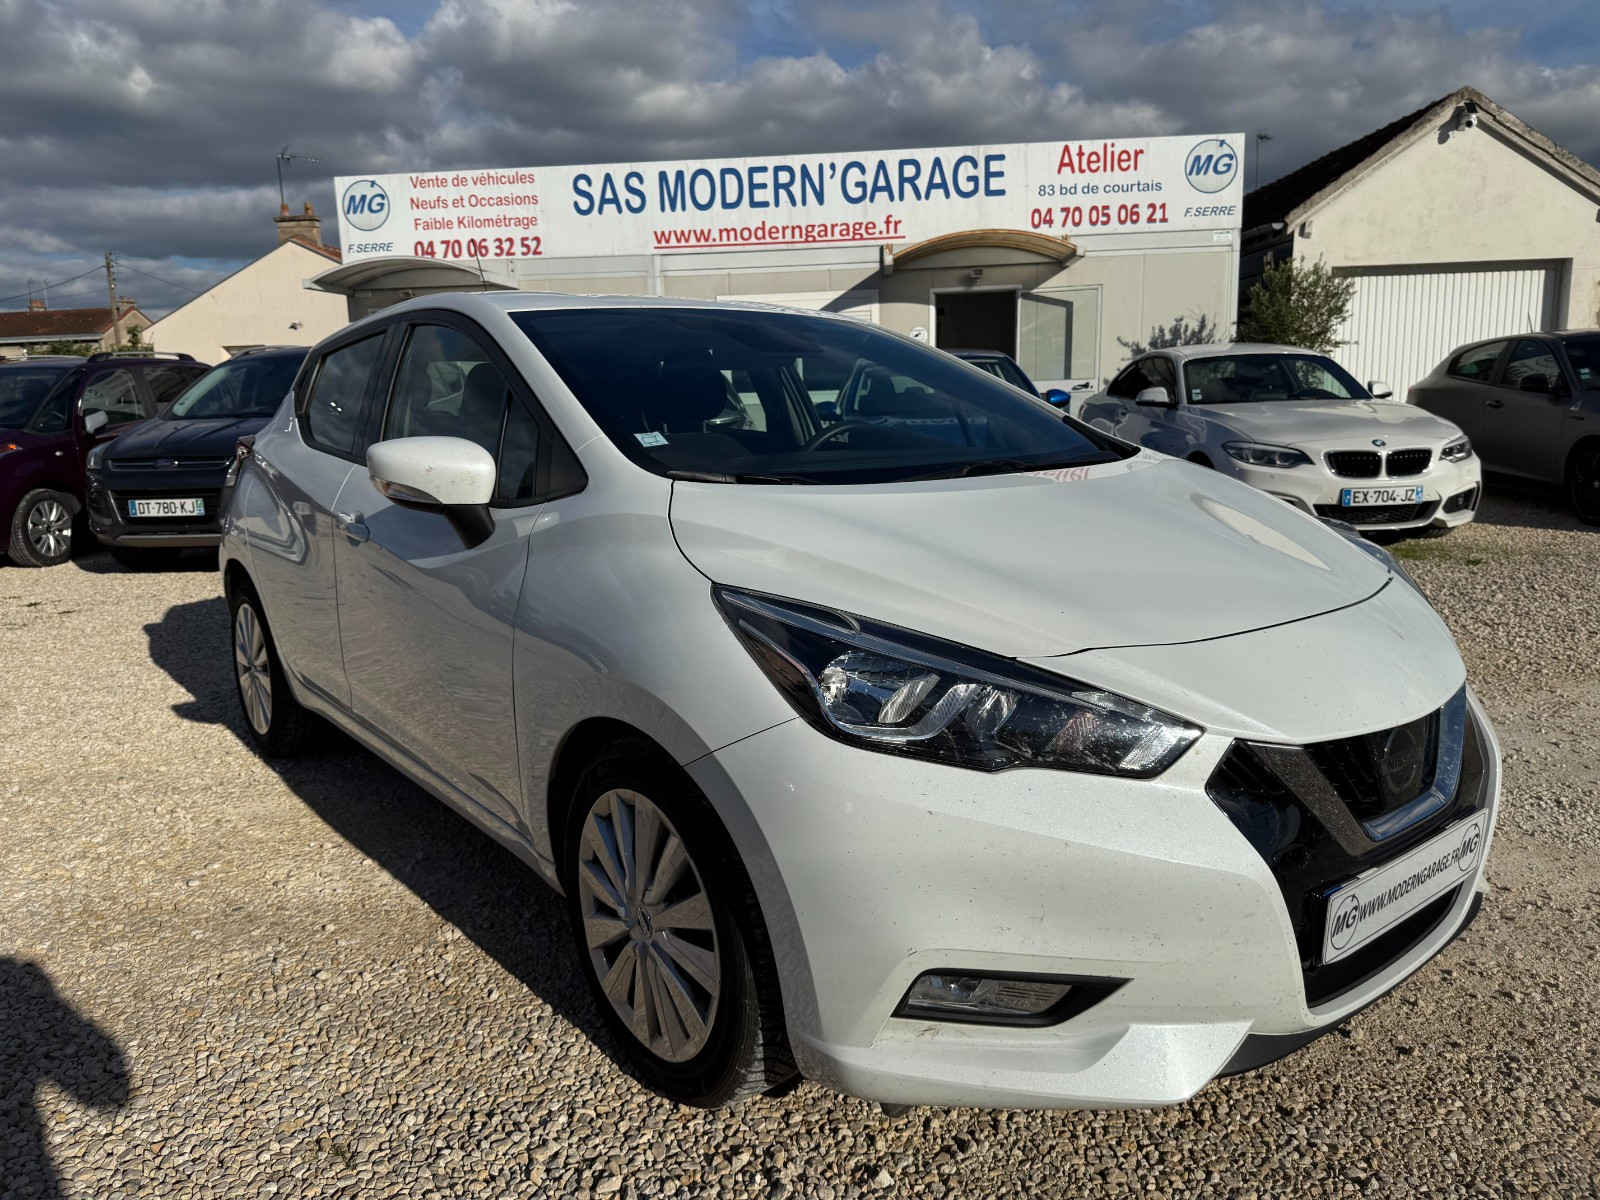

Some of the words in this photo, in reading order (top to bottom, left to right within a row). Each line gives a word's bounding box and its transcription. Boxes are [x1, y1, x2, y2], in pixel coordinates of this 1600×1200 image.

[1057, 142, 1144, 175] Atelier
[1188, 153, 1234, 176] MG
[410, 175, 448, 189] Vente
[452, 174, 468, 187] de
[471, 171, 535, 186] véhicules
[572, 171, 647, 216] SAS
[658, 154, 1006, 213] MODERN'GARAGE
[1038, 184, 1055, 196] 83
[1059, 183, 1077, 196] bd
[1081, 183, 1099, 194] de
[1103, 179, 1162, 193] courtais
[346, 193, 386, 215] MG
[410, 195, 448, 210] Neufs
[452, 195, 465, 208] et
[468, 193, 539, 208] Occasions
[1184, 205, 1237, 217] F.SERRE
[414, 217, 454, 231] Faible
[457, 214, 538, 230] Kilométrage
[1031, 207, 1054, 229] 04
[1060, 206, 1083, 228] 70
[1088, 205, 1111, 227] 05
[1117, 203, 1140, 225] 06
[1146, 202, 1169, 224] 21
[653, 214, 903, 245] www.moderngarage.fr
[347, 242, 394, 253] F.SERRE
[414, 240, 437, 258] 04
[440, 239, 463, 259] 70
[467, 238, 489, 258] 06
[493, 237, 516, 257] 32
[520, 236, 543, 256] 52
[1352, 488, 1415, 504] EX-704-JZ
[137, 501, 195, 515] DT-780-KJ
[1332, 905, 1358, 938] MG
[1359, 847, 1461, 922] WWW.MODERNGARAGE.FR
[1459, 833, 1480, 860] MG
